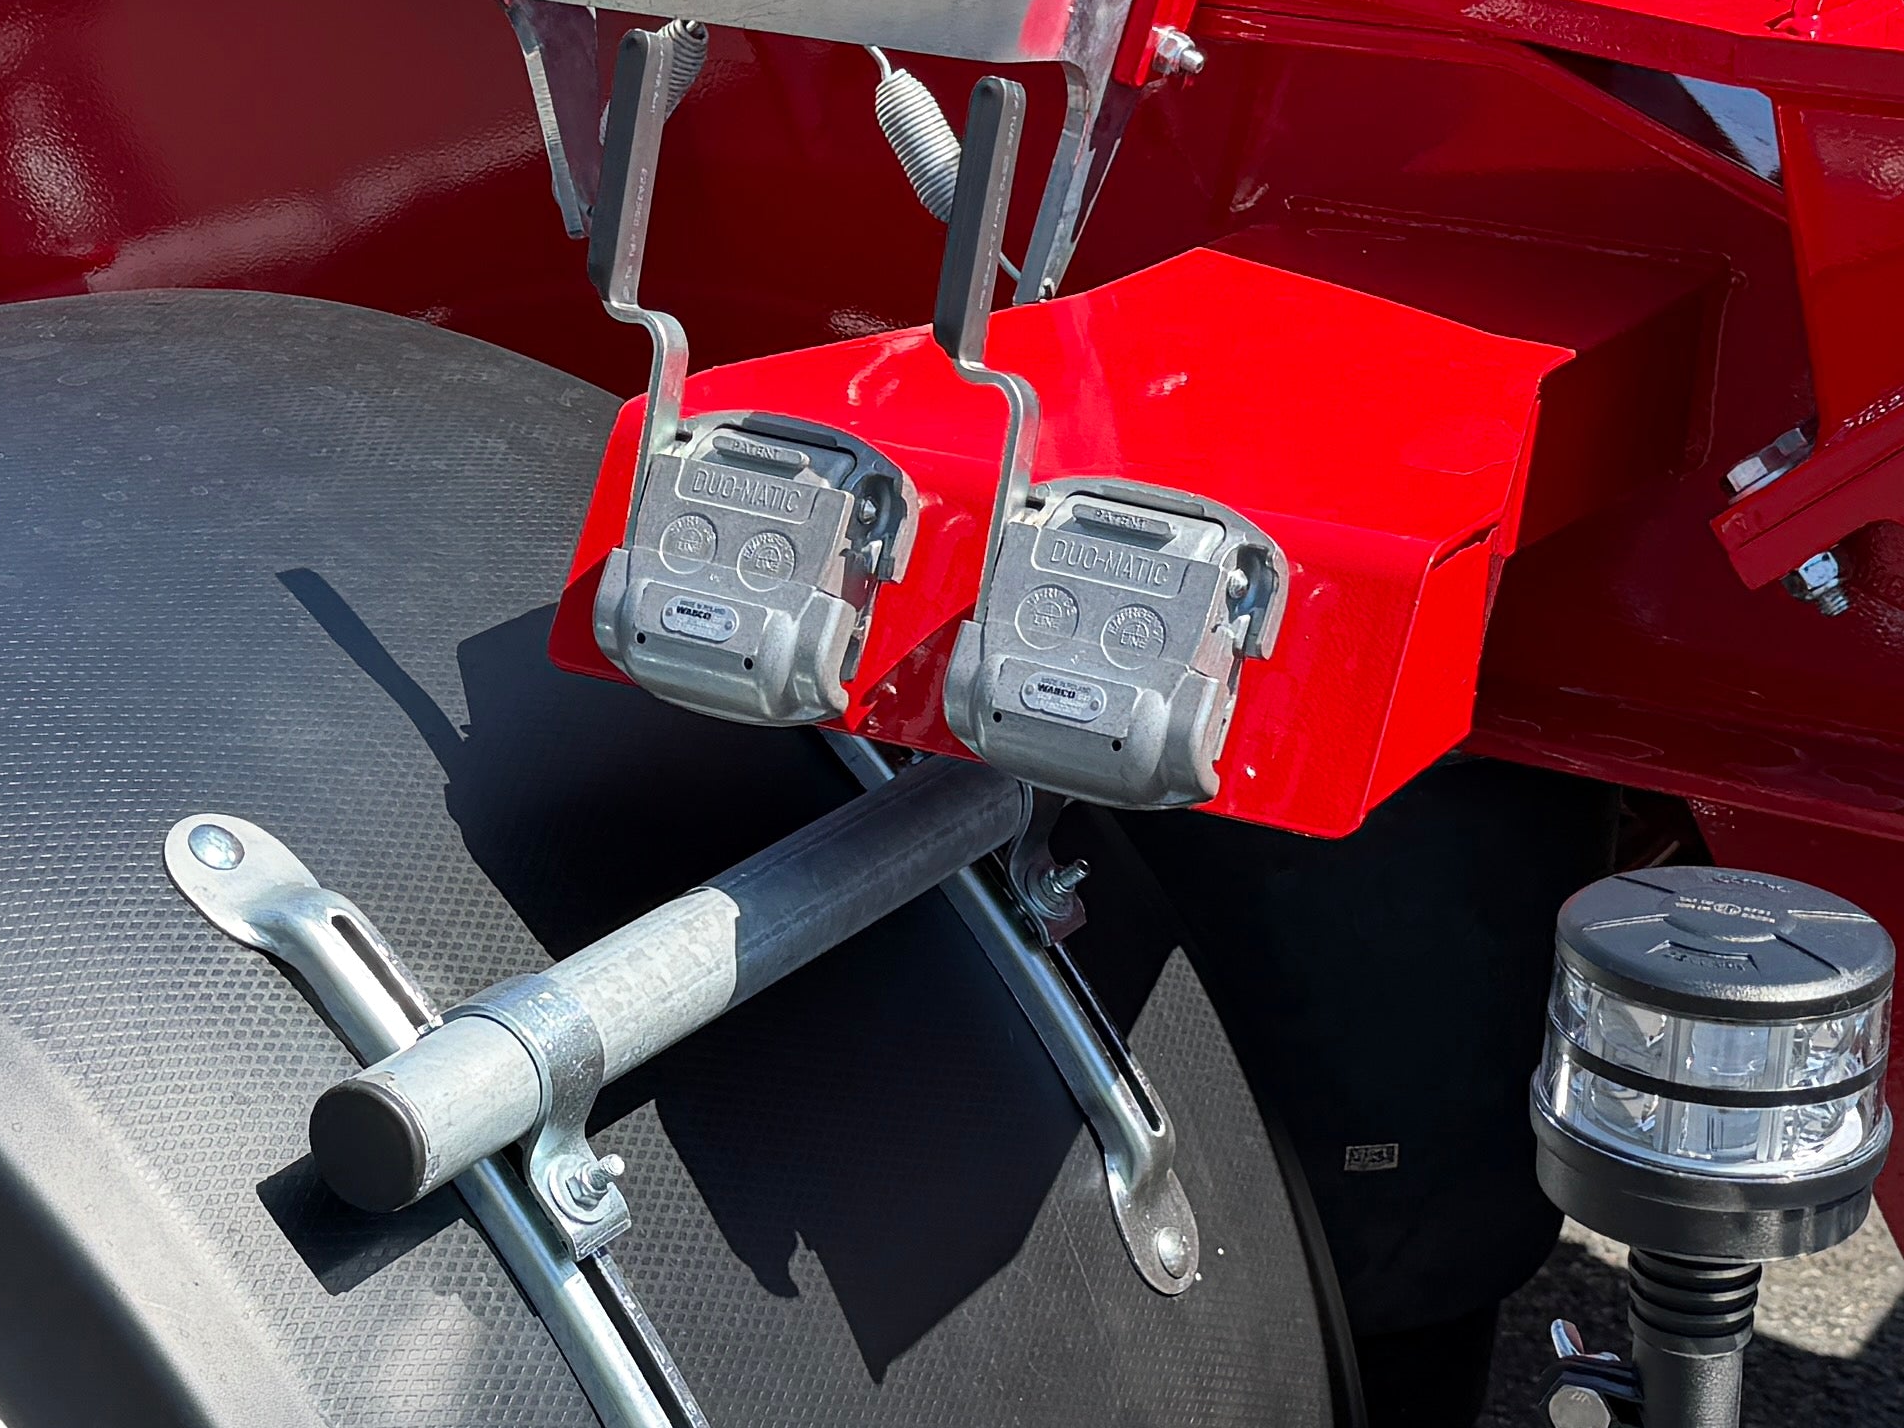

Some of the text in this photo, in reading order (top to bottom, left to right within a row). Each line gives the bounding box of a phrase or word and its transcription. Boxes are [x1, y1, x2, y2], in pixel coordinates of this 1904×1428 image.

[692, 468, 802, 514] DUO-MATIC
[1050, 539, 1171, 586] DUO-MATIC
[676, 605, 712, 622] WABCO
[1037, 683, 1076, 700] WABCO
